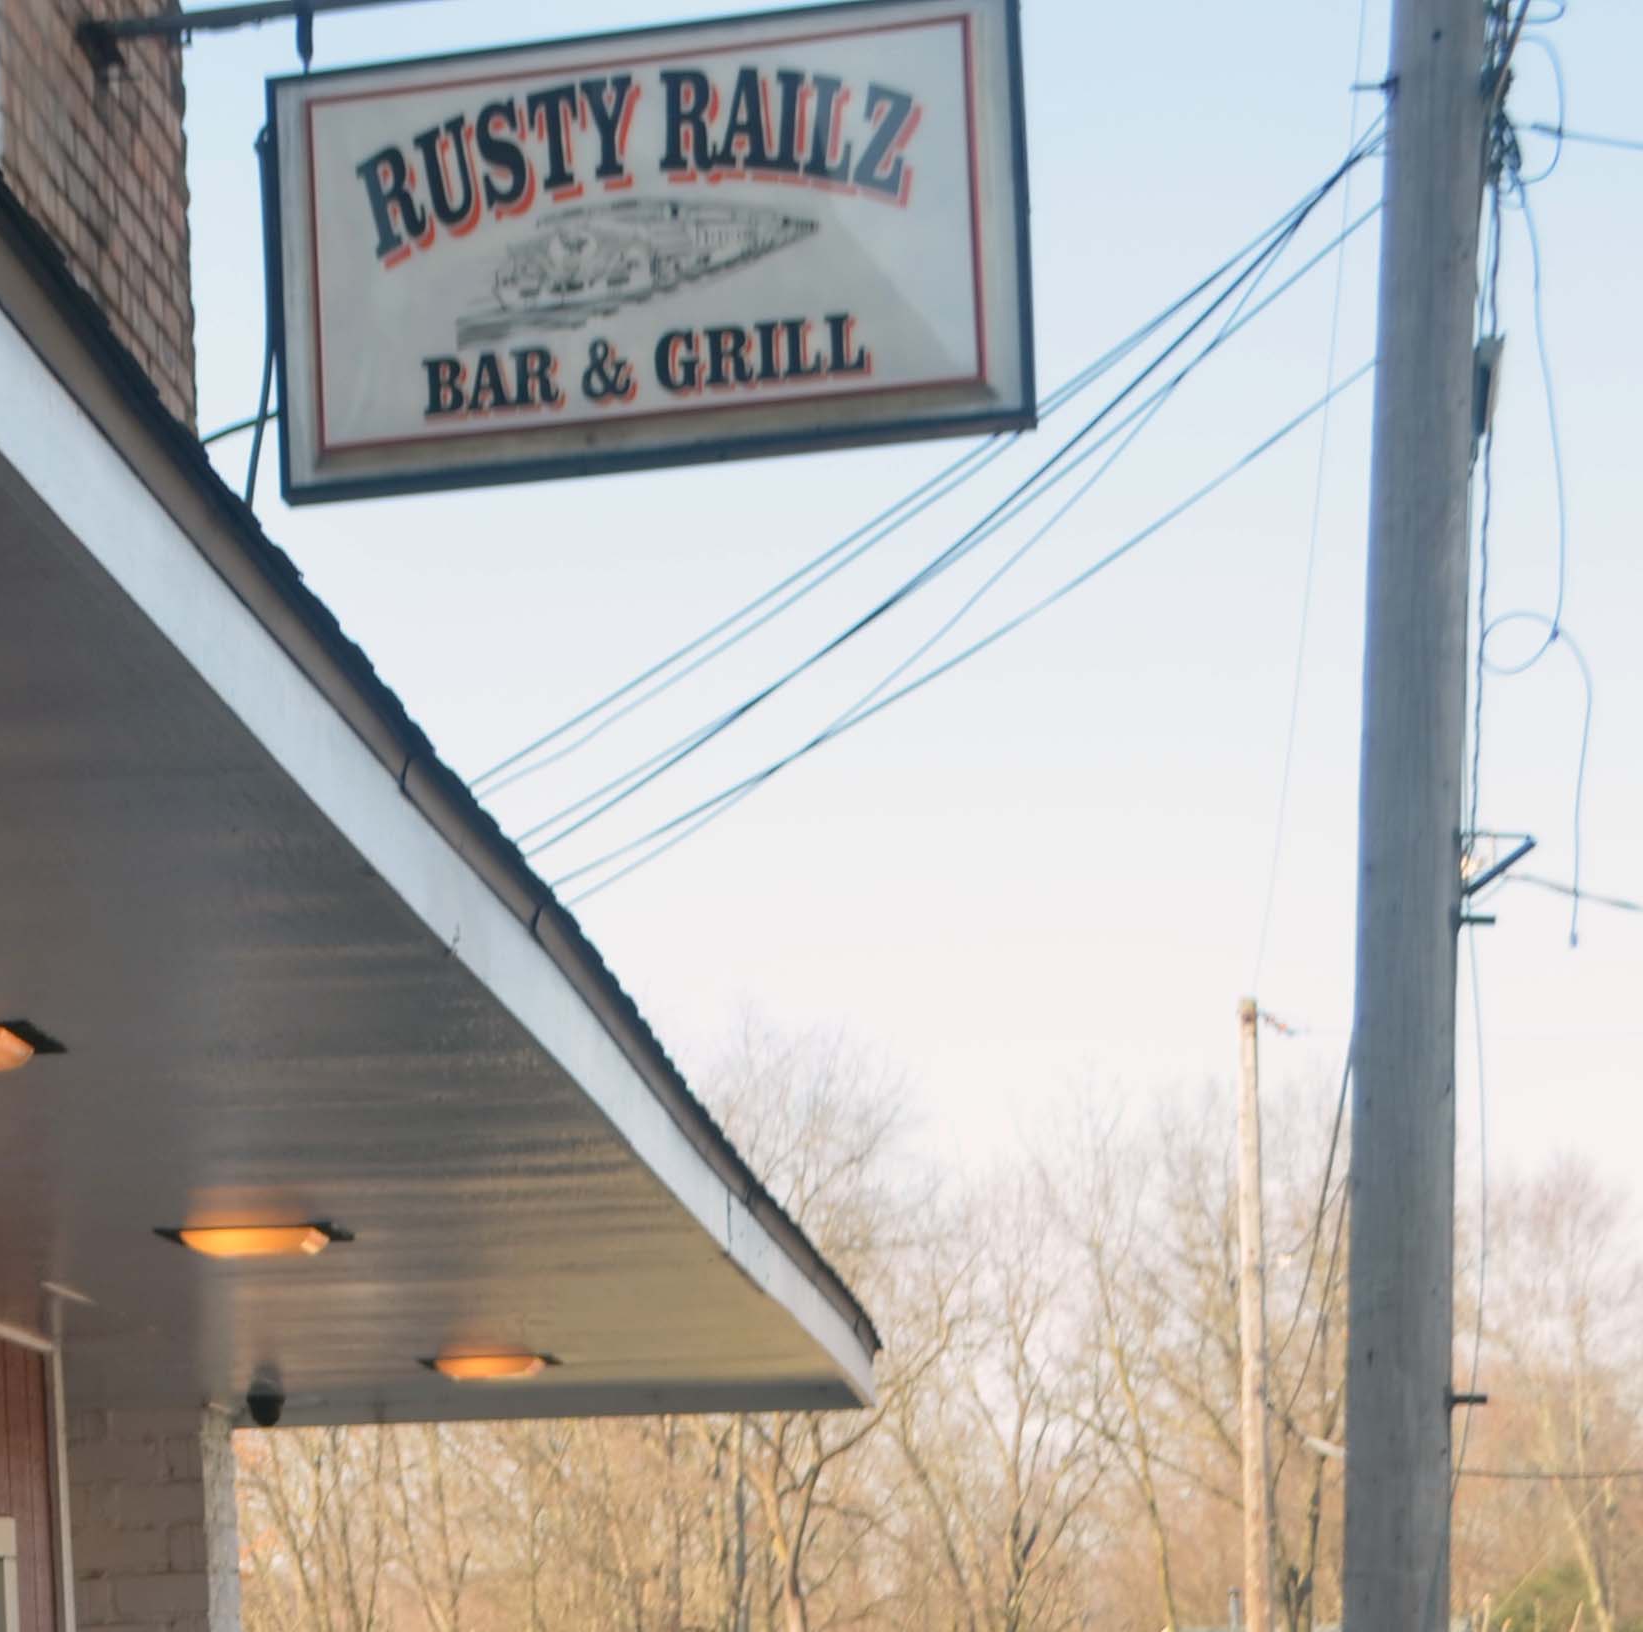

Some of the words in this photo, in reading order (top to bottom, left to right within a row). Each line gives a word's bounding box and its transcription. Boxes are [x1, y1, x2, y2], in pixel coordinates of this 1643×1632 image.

[356, 75, 640, 268] RUSTY
[659, 65, 922, 208] RAILZ
[422, 344, 565, 422] BAR
[581, 341, 638, 403] &
[654, 314, 871, 392] GRILL
